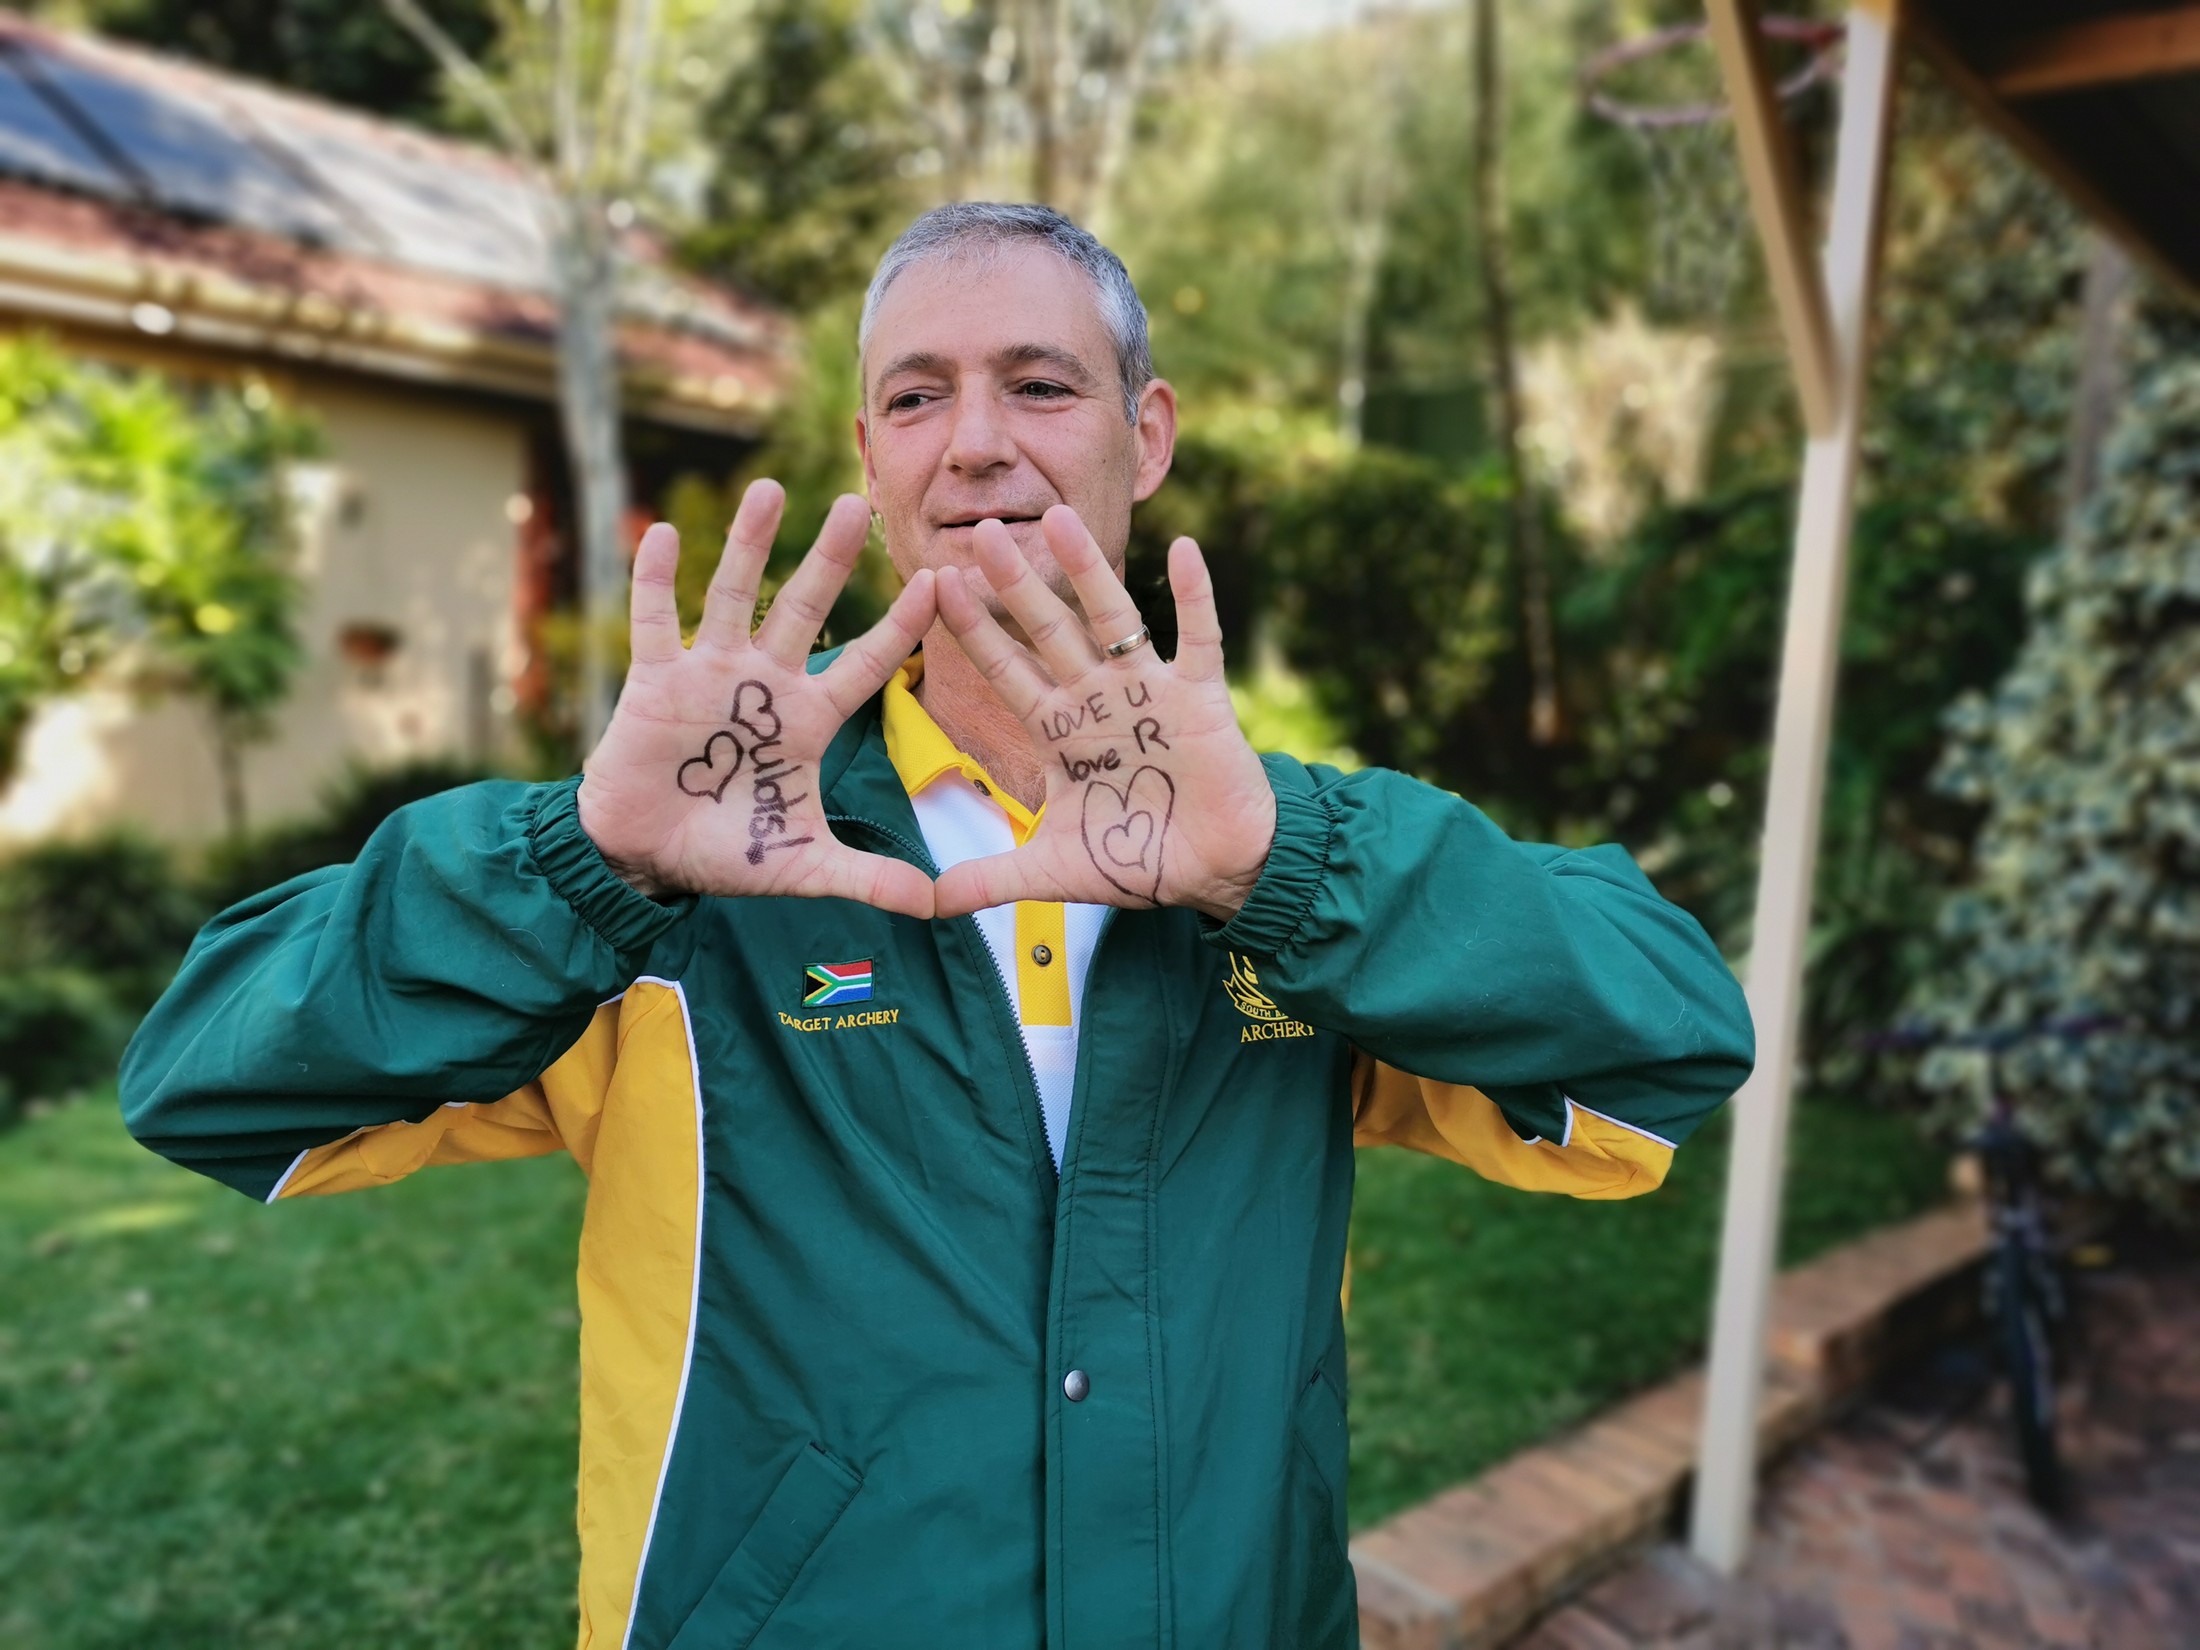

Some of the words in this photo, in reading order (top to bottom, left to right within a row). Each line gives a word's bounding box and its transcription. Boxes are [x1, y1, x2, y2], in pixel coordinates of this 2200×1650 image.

[1041, 691, 1112, 742] LOVE
[1058, 747, 1122, 783] love
[1132, 717, 1170, 754] R
[778, 1011, 832, 1032] TARGET
[835, 1008, 900, 1030] ARCHERY
[1240, 1001, 1272, 1018] SOUTH
